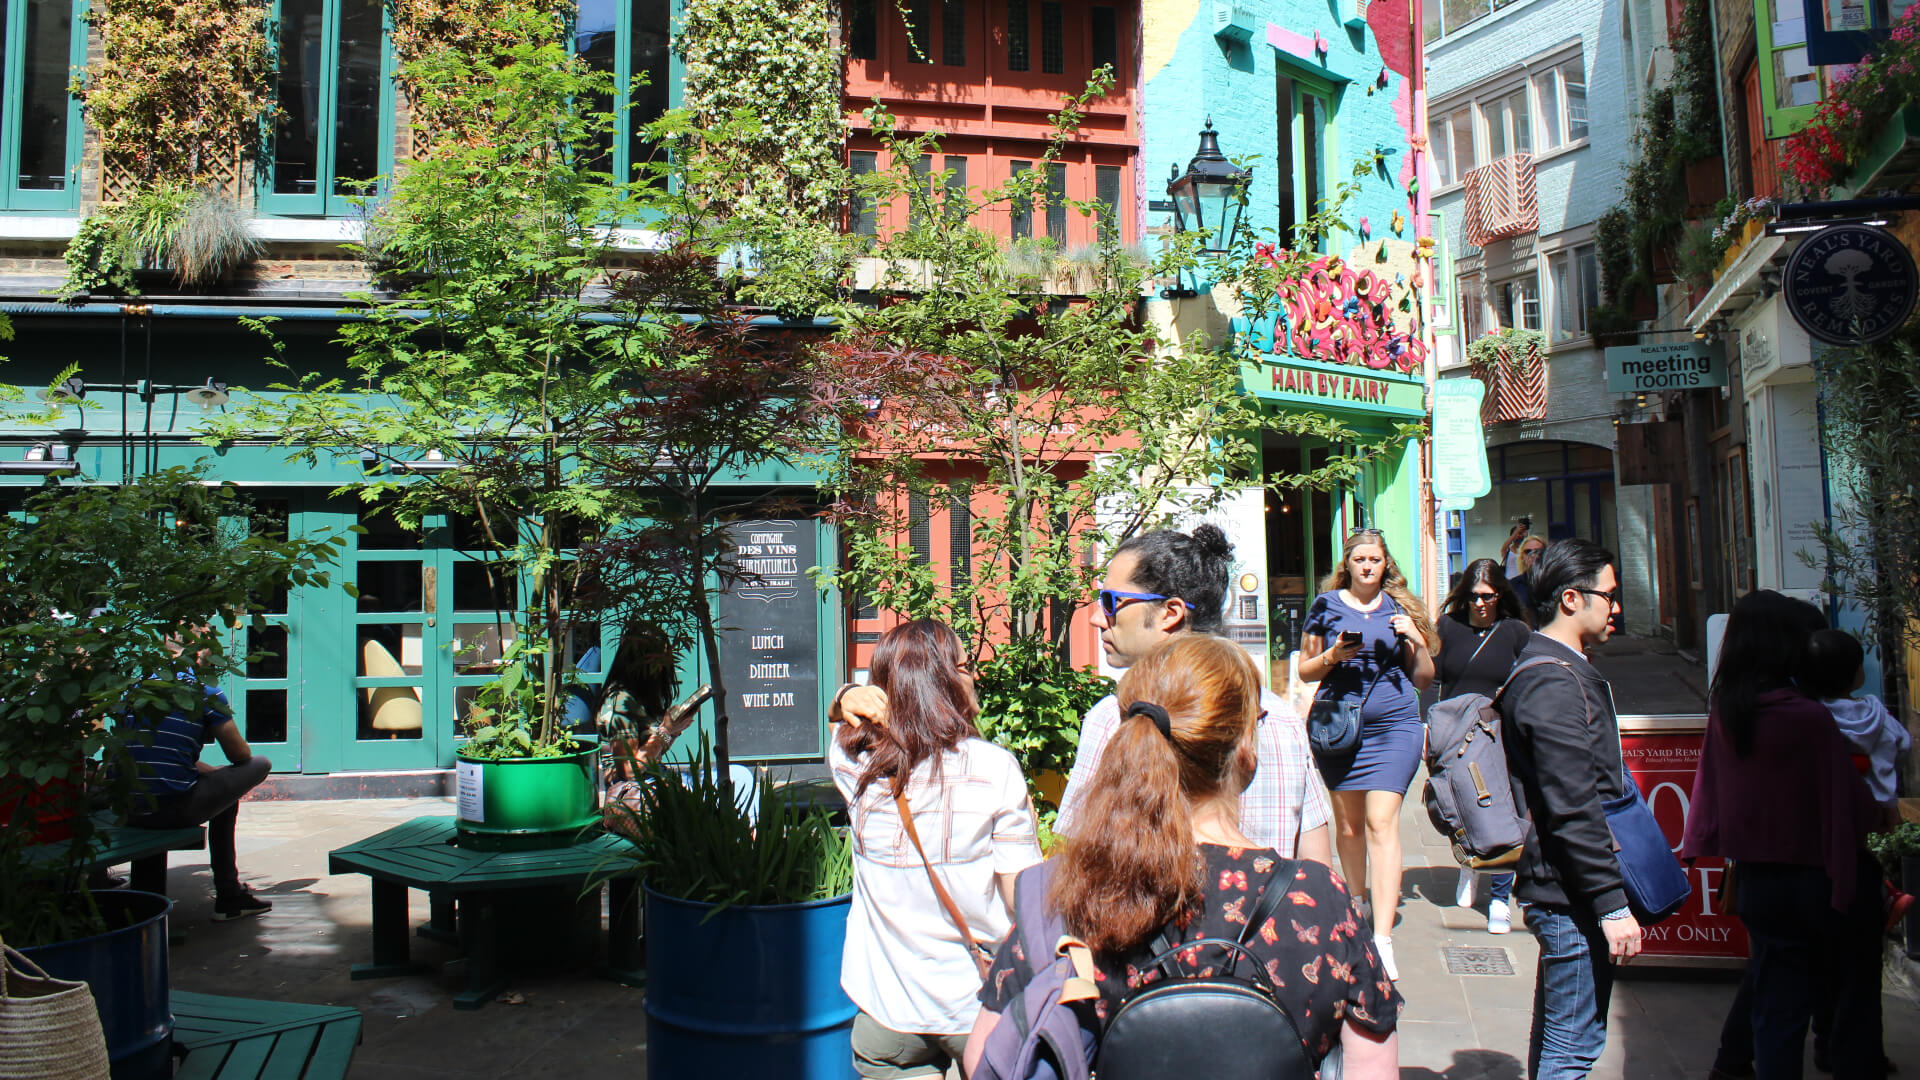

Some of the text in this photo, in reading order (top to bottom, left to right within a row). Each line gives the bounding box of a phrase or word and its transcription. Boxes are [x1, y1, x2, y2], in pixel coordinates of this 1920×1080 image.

[1796, 233, 1903, 282] NEAL'S YARD
[1797, 279, 1907, 296] COVENT GARDEN
[1803, 294, 1904, 333] REMDIES
[1641, 345, 1689, 354] NEAL'S YARD
[1622, 354, 1711, 374] meeting
[1272, 367, 1389, 404] HAIR BY FAIRY
[1635, 372, 1700, 388] rooms
[751, 533, 783, 544] COMPAGNIE
[738, 545, 797, 555] DES VINS
[738, 558, 798, 574] SURNATURELS
[752, 635, 784, 649] LUNCH
[750, 663, 790, 678] DINNER
[742, 692, 795, 708] WINE BAR
[1621, 749, 1645, 757] EAL'S
[1646, 748, 1673, 757] YARD
[1677, 924, 1731, 942] ONLY
